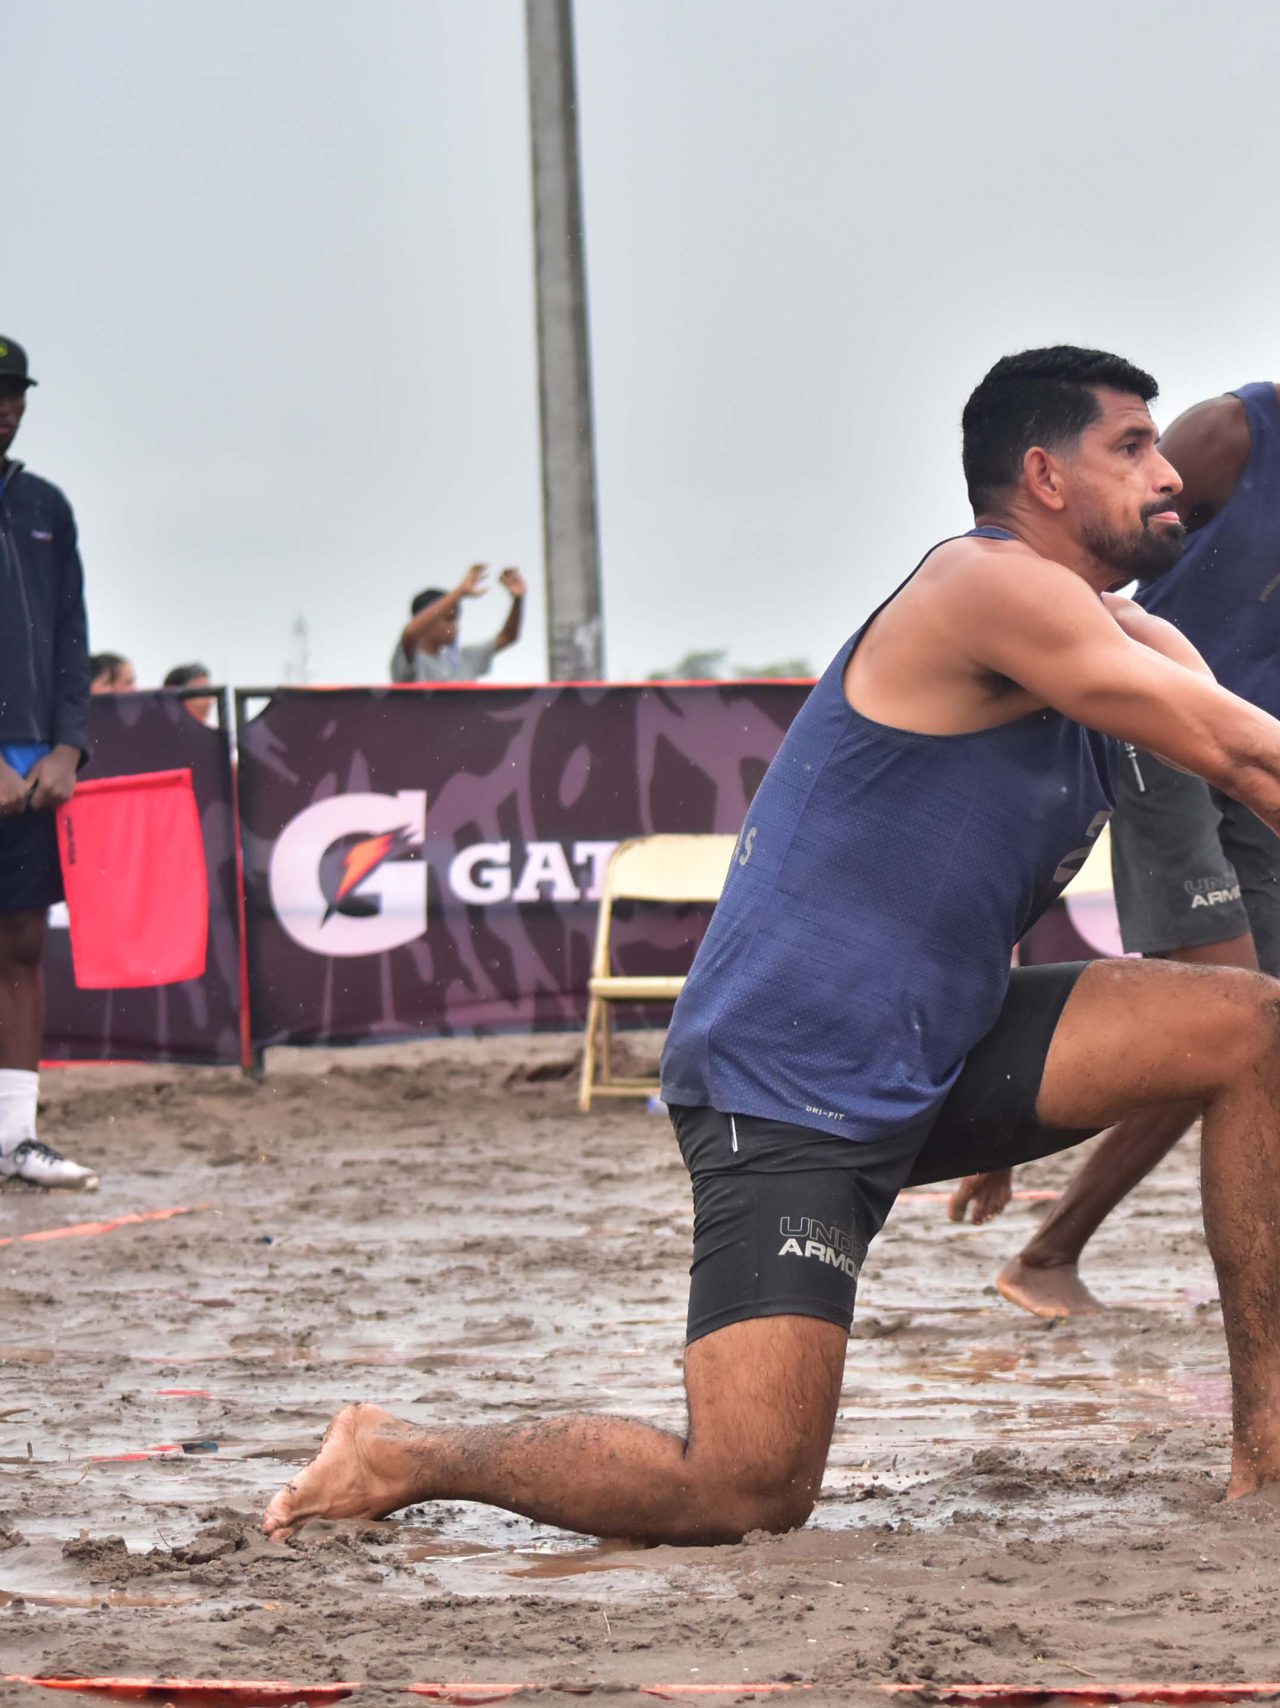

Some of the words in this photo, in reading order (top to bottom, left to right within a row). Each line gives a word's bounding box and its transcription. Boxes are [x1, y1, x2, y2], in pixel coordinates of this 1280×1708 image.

[269, 789, 428, 958] G
[805, 1105, 846, 1121] DRI-FIT
[777, 1237, 859, 1283] ARMO
